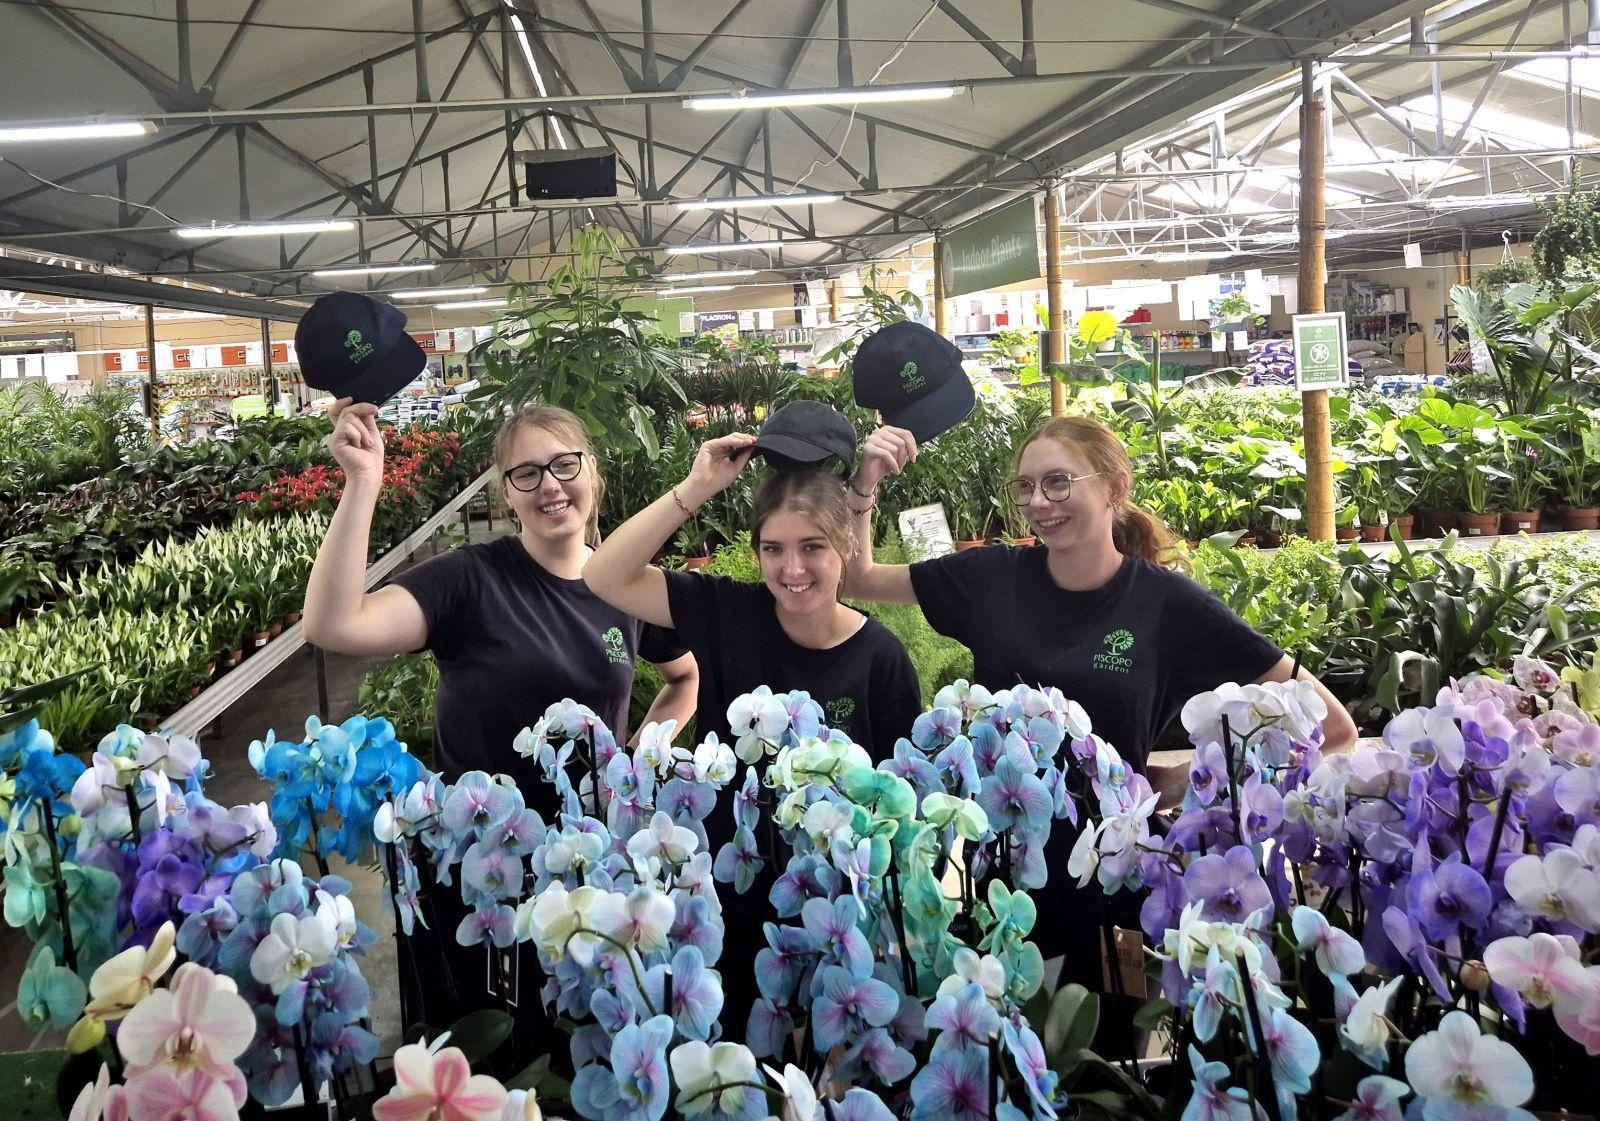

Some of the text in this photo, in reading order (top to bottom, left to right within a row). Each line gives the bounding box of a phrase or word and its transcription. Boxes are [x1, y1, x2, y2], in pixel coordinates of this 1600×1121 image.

[962, 235, 1022, 273] Indoor Plants
[1093, 653, 1133, 668] PISCOPO
[1093, 662, 1129, 674] gardens
